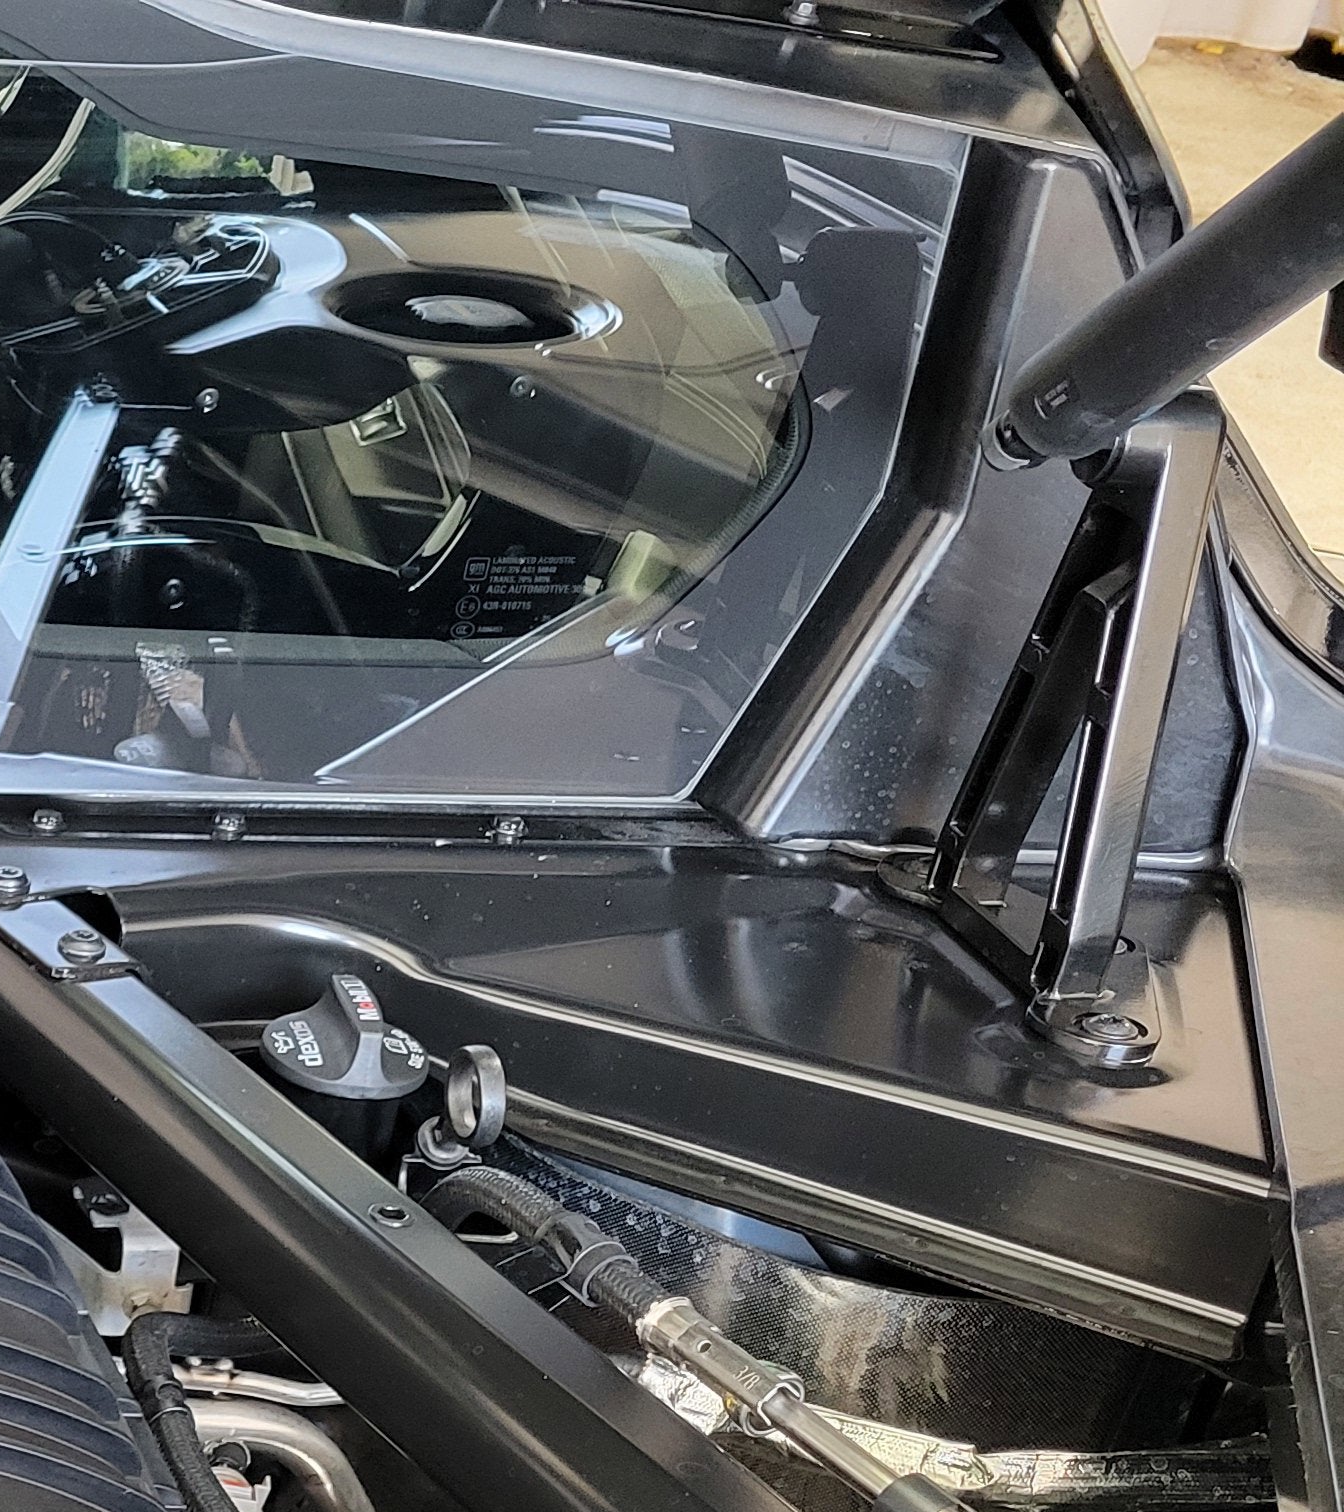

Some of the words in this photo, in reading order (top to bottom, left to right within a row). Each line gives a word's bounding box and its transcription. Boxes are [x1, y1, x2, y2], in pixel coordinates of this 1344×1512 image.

[486, 584, 507, 594] AGC
[507, 584, 570, 594] AUTOMOTIVE
[348, 989, 380, 1021] Mobil
[288, 1020, 324, 1067] dexos
